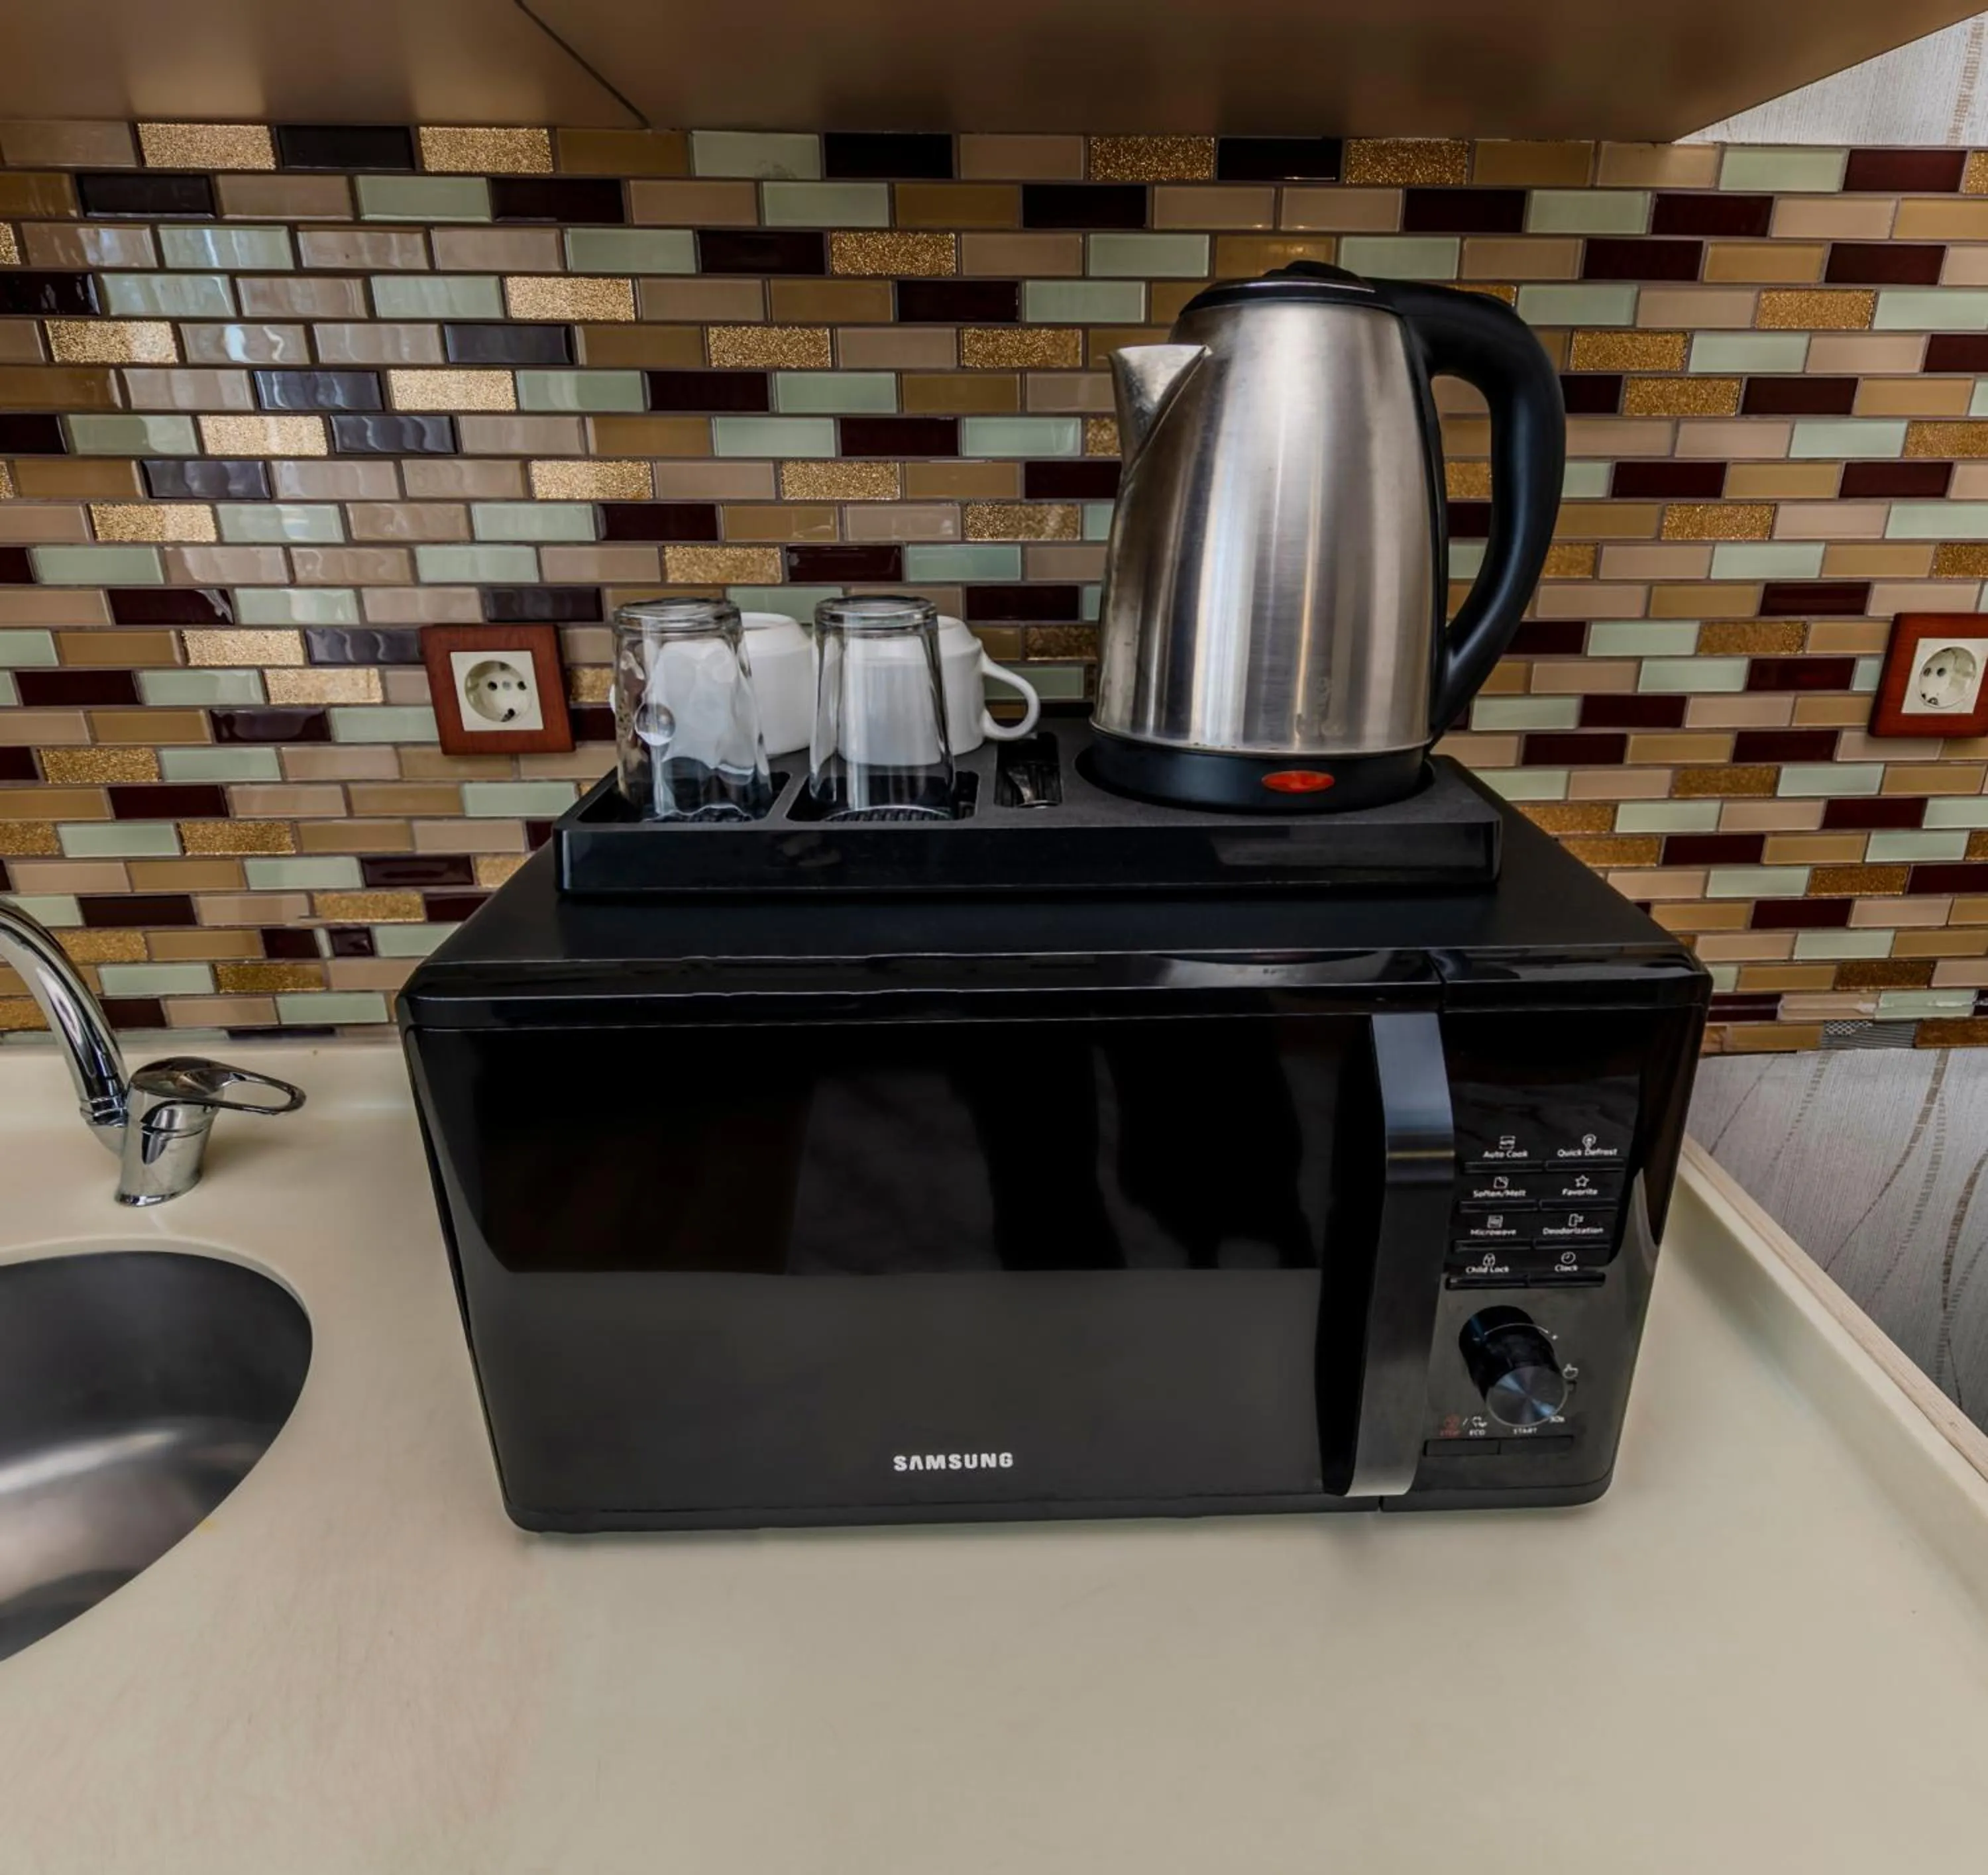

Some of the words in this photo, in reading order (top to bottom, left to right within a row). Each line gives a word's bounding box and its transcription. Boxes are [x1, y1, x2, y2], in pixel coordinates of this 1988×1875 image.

[1506, 1150, 1528, 1158] Cook
[1557, 1148, 1582, 1157] Quick
[1584, 1148, 1618, 1156] Defrost
[1543, 1227, 1604, 1236] Deodorization
[893, 1452, 1014, 1472] SAMSUNG
